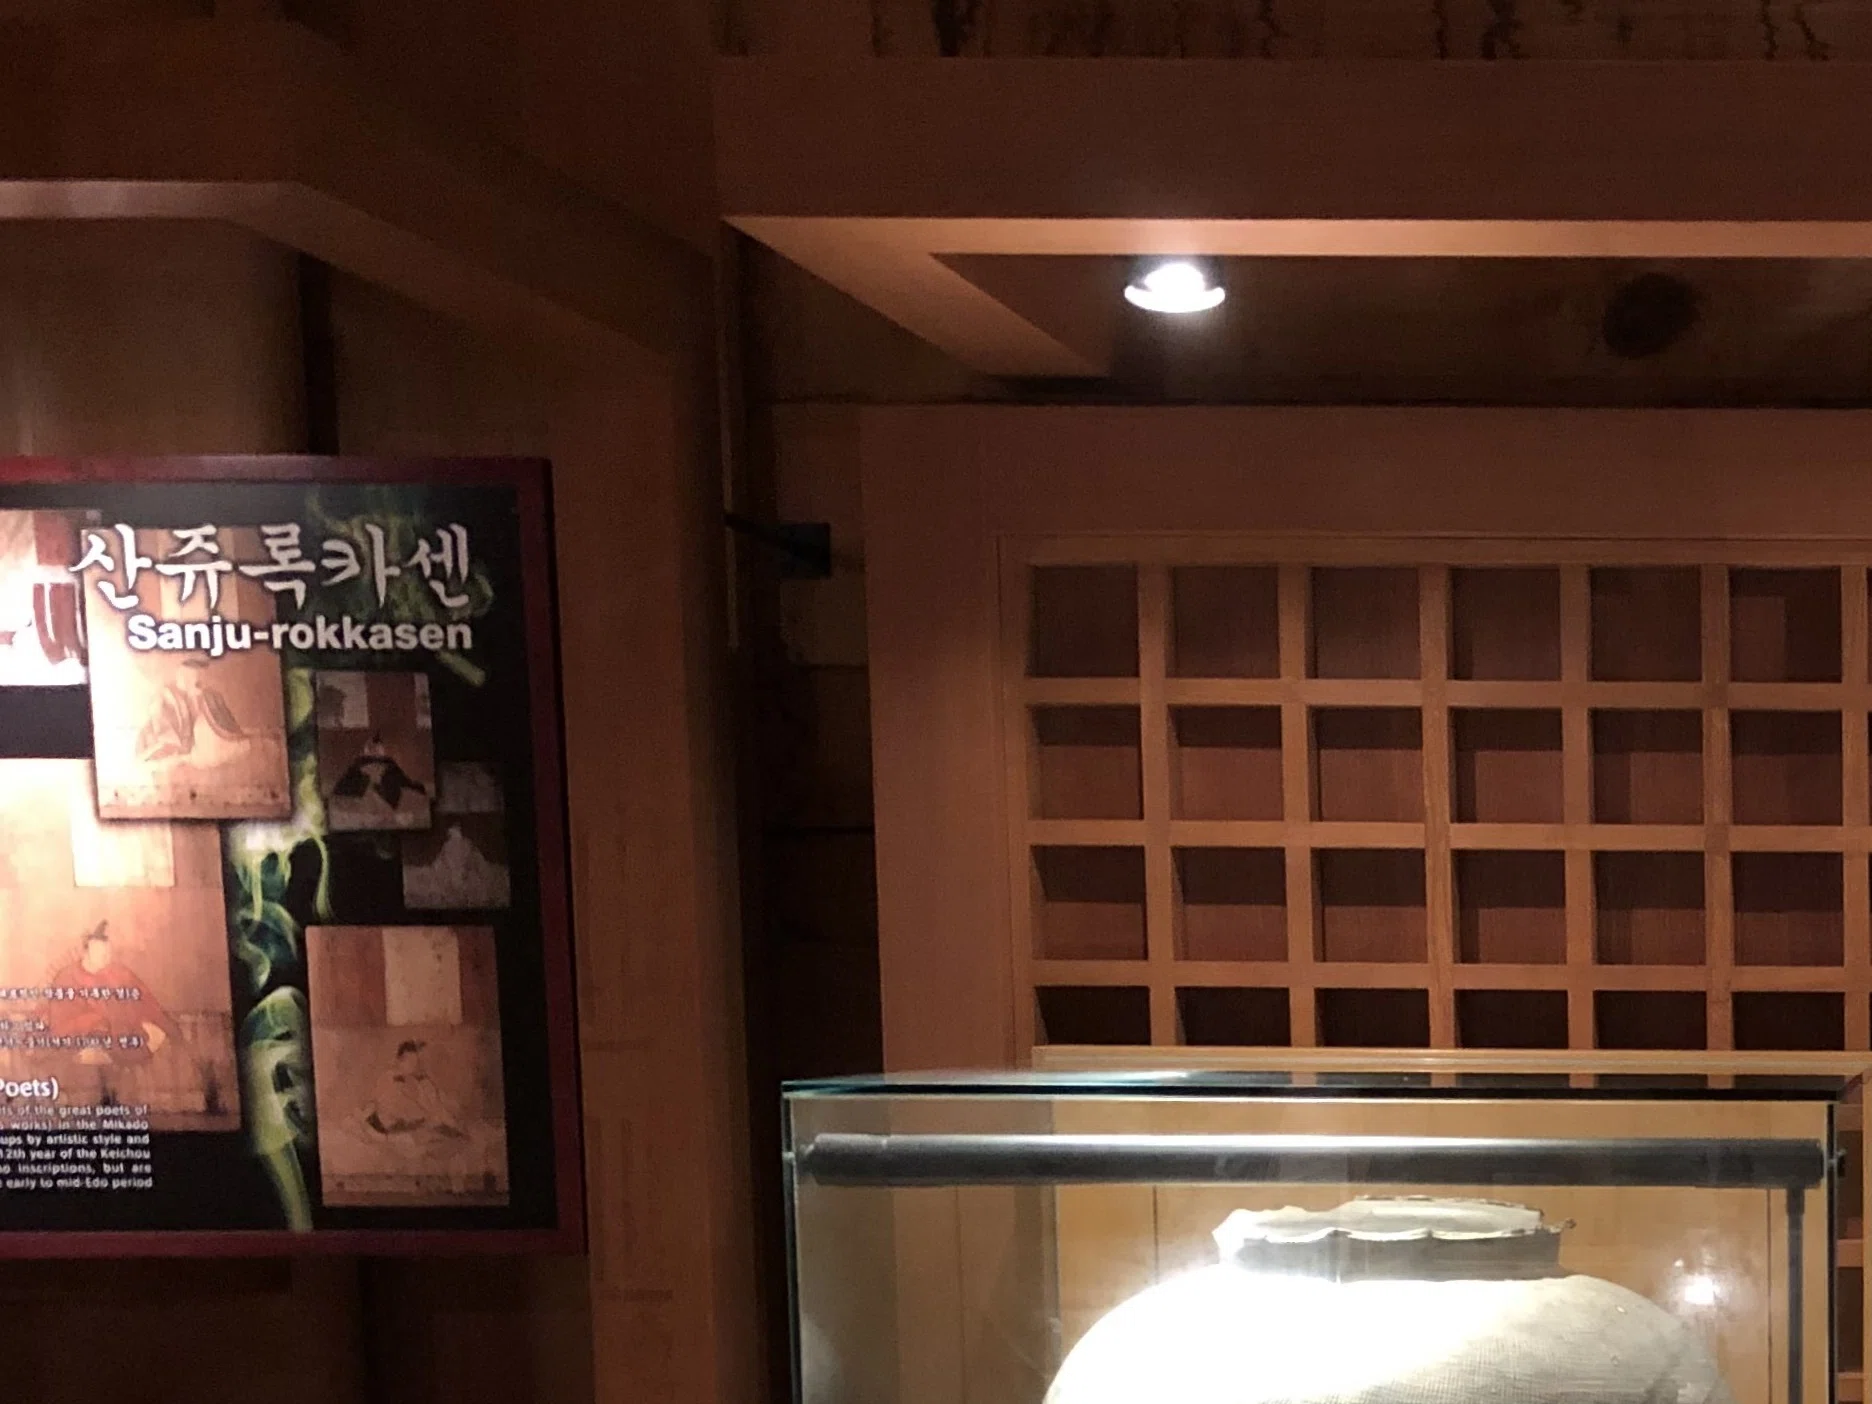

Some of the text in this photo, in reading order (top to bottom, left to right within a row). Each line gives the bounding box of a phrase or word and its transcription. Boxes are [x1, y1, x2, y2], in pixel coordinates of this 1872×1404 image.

[68, 523, 469, 610] 산쥬록카센
[128, 615, 472, 656] Sanju-rokkasen
[46, 1134, 89, 1145] artistic
[93, 1134, 122, 1147] style
[127, 1134, 150, 1145] and
